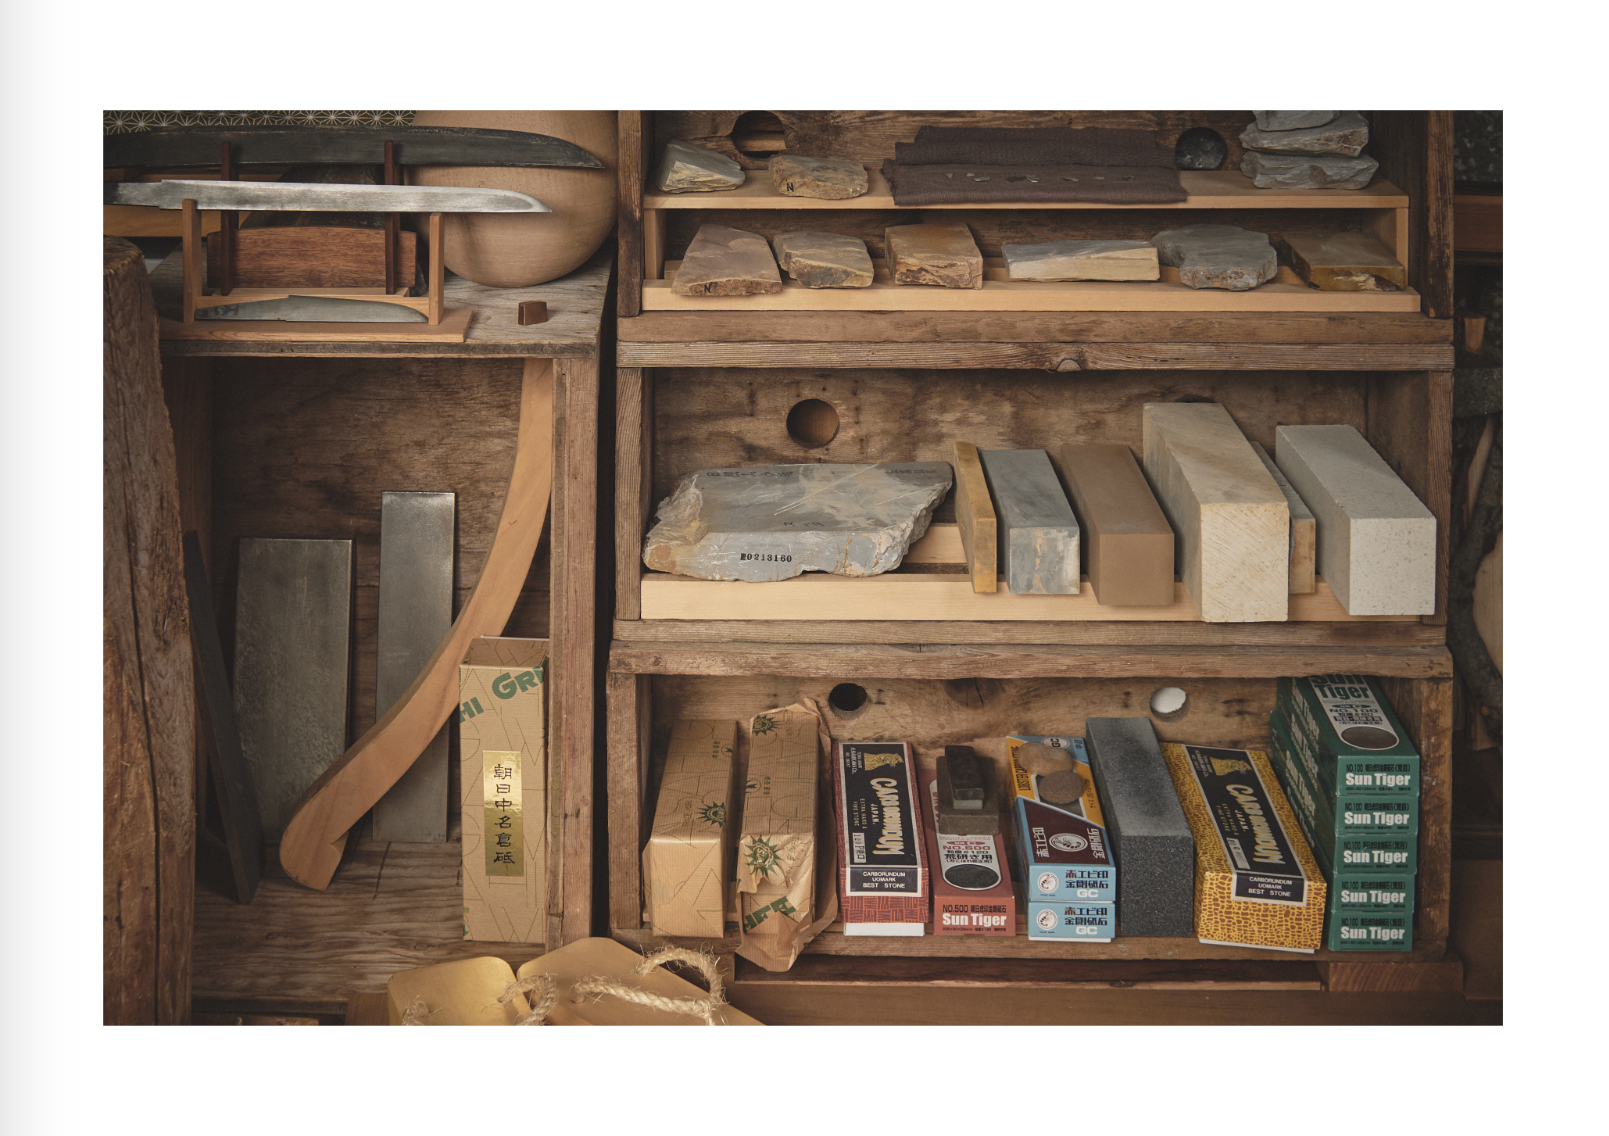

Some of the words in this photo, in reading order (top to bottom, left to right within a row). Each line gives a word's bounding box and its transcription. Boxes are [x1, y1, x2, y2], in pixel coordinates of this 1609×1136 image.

[786, 182, 794, 192] N
[1313, 684, 1369, 700] Tiger
[1346, 773, 1372, 786] Sun
[1374, 773, 1411, 787] Tiger
[493, 763, 515, 864] 朝日中名倉砥
[870, 777, 905, 855] CARBORUNDUM
[1345, 811, 1371, 824] Sun
[1373, 812, 1410, 826] Tiger
[1226, 784, 1286, 864] CARBORUNDUM
[1343, 850, 1370, 863] Sun
[1371, 850, 1408, 864] Tiger
[1065, 870, 1108, 879] 赤エビ印
[1249, 876, 1292, 885] CARBORUNDUM
[1077, 889, 1098, 898] GC
[1341, 890, 1367, 903] Sun
[1369, 890, 1406, 904] Tiger
[943, 904, 968, 913] NO.500
[1064, 907, 1107, 916] 赤エビ印
[942, 913, 968, 926] Sun
[971, 913, 1007, 927] Tiger
[1076, 926, 1098, 935] GC
[1340, 926, 1367, 939] Sun
[1369, 926, 1405, 941] Tiger
